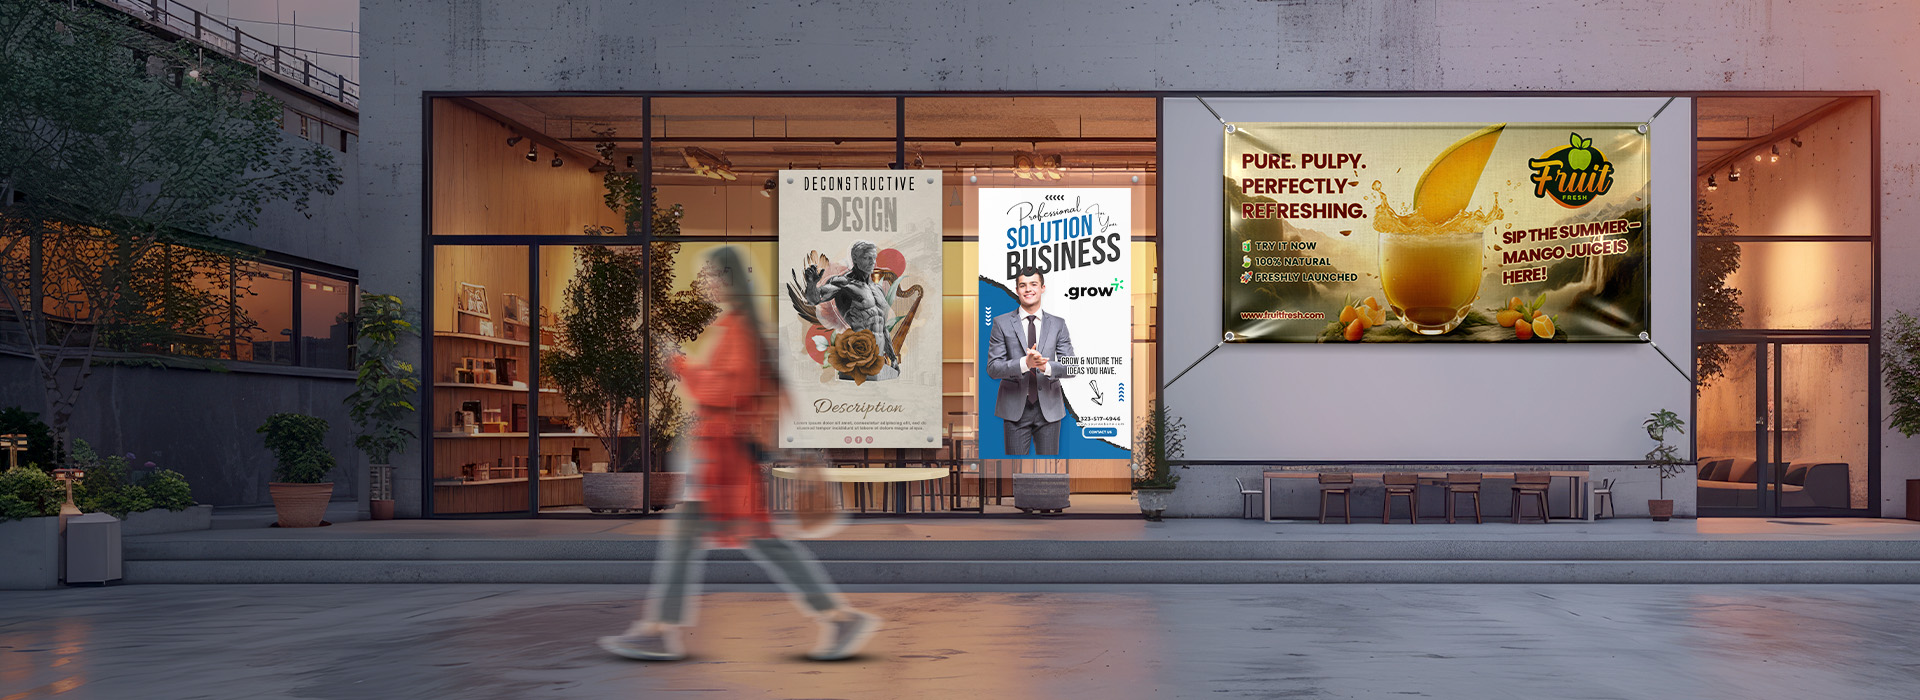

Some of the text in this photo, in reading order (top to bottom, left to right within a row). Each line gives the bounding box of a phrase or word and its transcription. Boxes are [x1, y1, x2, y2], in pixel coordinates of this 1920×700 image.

[1242, 153, 1367, 169] PURE. PULPY.
[804, 176, 915, 191] DECONSTRUCTIVE
[1242, 178, 1348, 194] PERFECTLY
[1530, 160, 1612, 196] Fruit
[820, 196, 897, 232] DESIGN
[1006, 195, 1081, 227] Professional
[1242, 202, 1368, 219] REFRESHING.
[1006, 213, 1093, 250] SOLUTION
[1502, 229, 1527, 244] SIP
[1528, 226, 1558, 242] THE
[1256, 242, 1317, 250] TRY IT NOW
[1502, 240, 1628, 265] MANGO JUICE IS
[1006, 232, 1121, 281] BUSINESS
[1256, 257, 1331, 266] 100% NATURAL
[1256, 273, 1358, 282] FRESHLY LAUNCHED
[1502, 266, 1547, 285] HERE!
[1240, 310, 1325, 320] www.fruitfresh.com
[1061, 356, 1123, 365] GROW & NUTURE THE
[1067, 366, 1117, 375] IDEAS YOU HAVE.
[813, 398, 905, 420] Description
